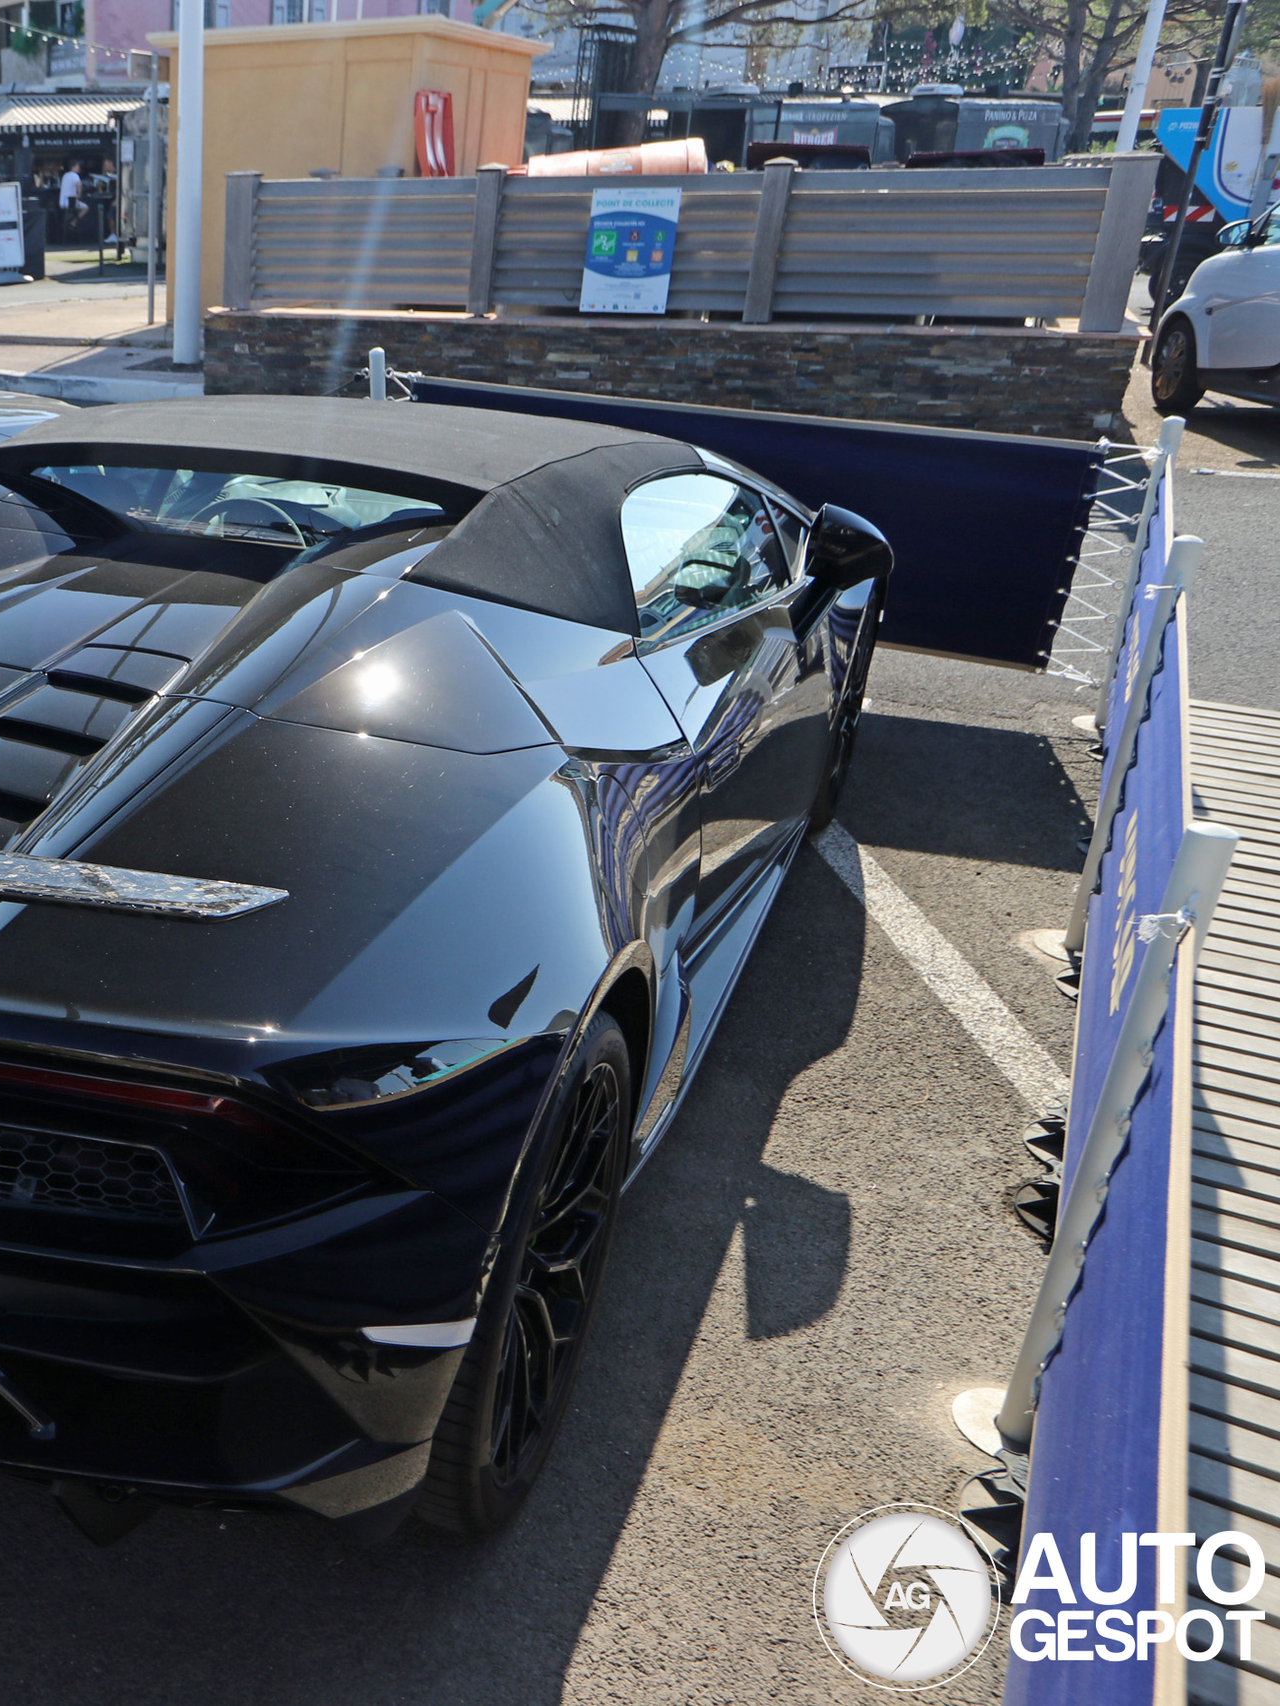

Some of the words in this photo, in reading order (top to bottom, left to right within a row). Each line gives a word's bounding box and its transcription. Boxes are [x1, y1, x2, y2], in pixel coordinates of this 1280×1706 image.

[596, 199, 620, 208] POINT
[622, 199, 634, 208] DE
[635, 199, 675, 208] COLLECTE
